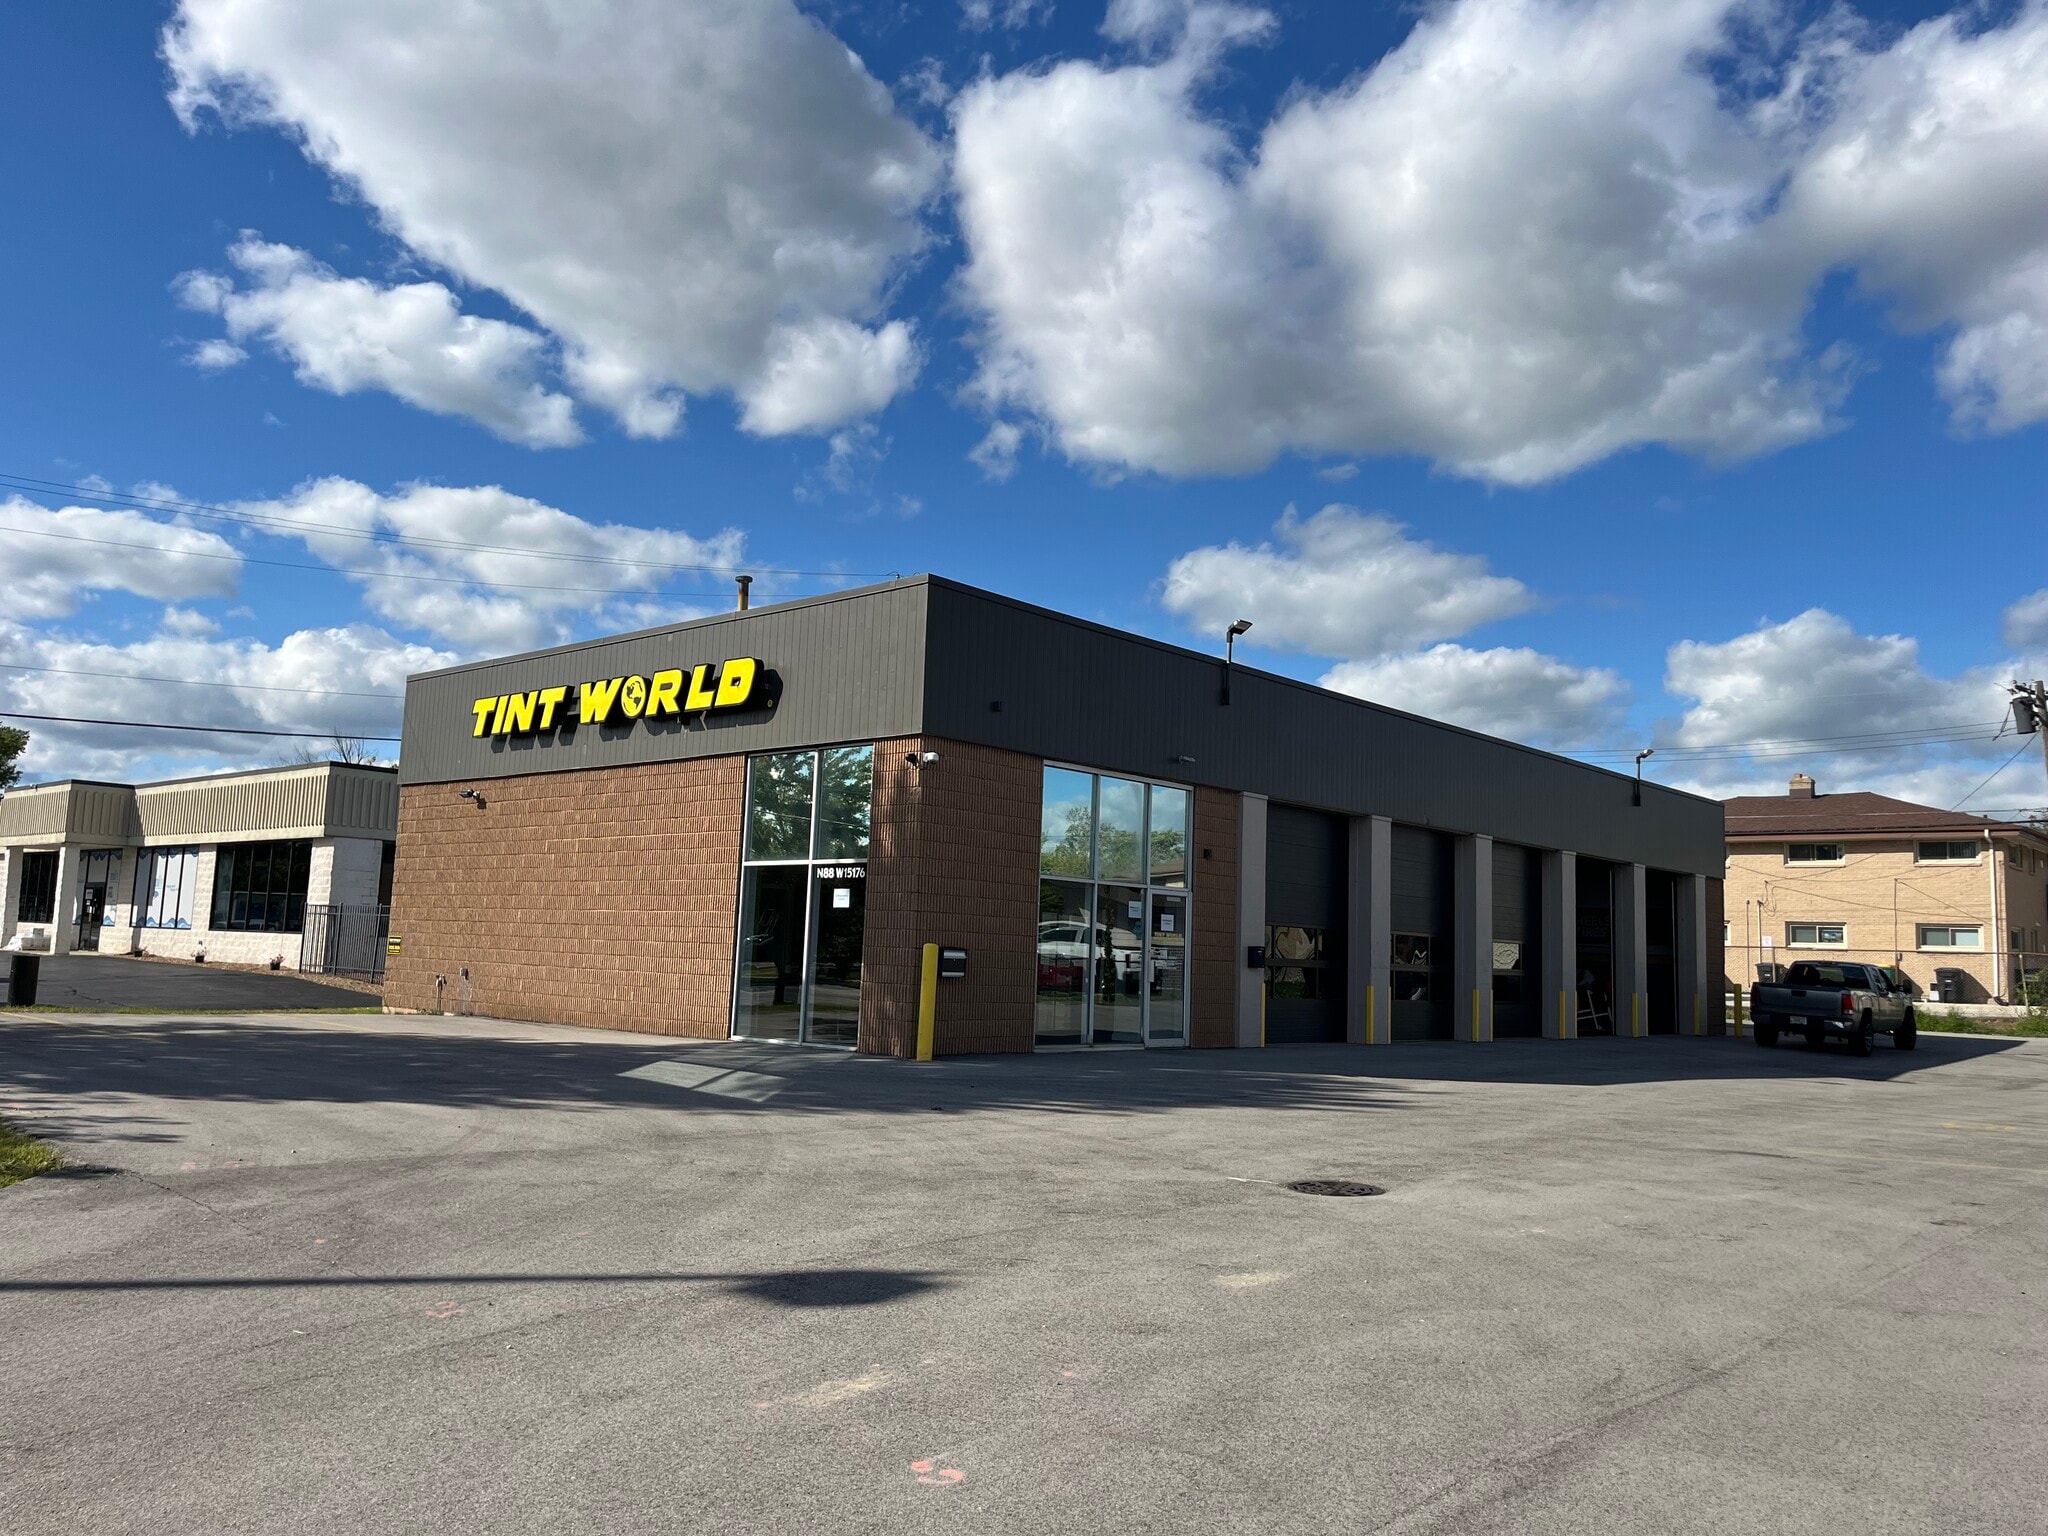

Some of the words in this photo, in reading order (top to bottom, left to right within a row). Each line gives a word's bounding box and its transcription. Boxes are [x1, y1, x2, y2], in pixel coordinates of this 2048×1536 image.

[471, 685, 568, 738] TINT
[579, 657, 757, 725] WORLD
[816, 867, 835, 879] N88
[835, 867, 866, 879] W15176
[1577, 915, 1610, 927] HEELS
